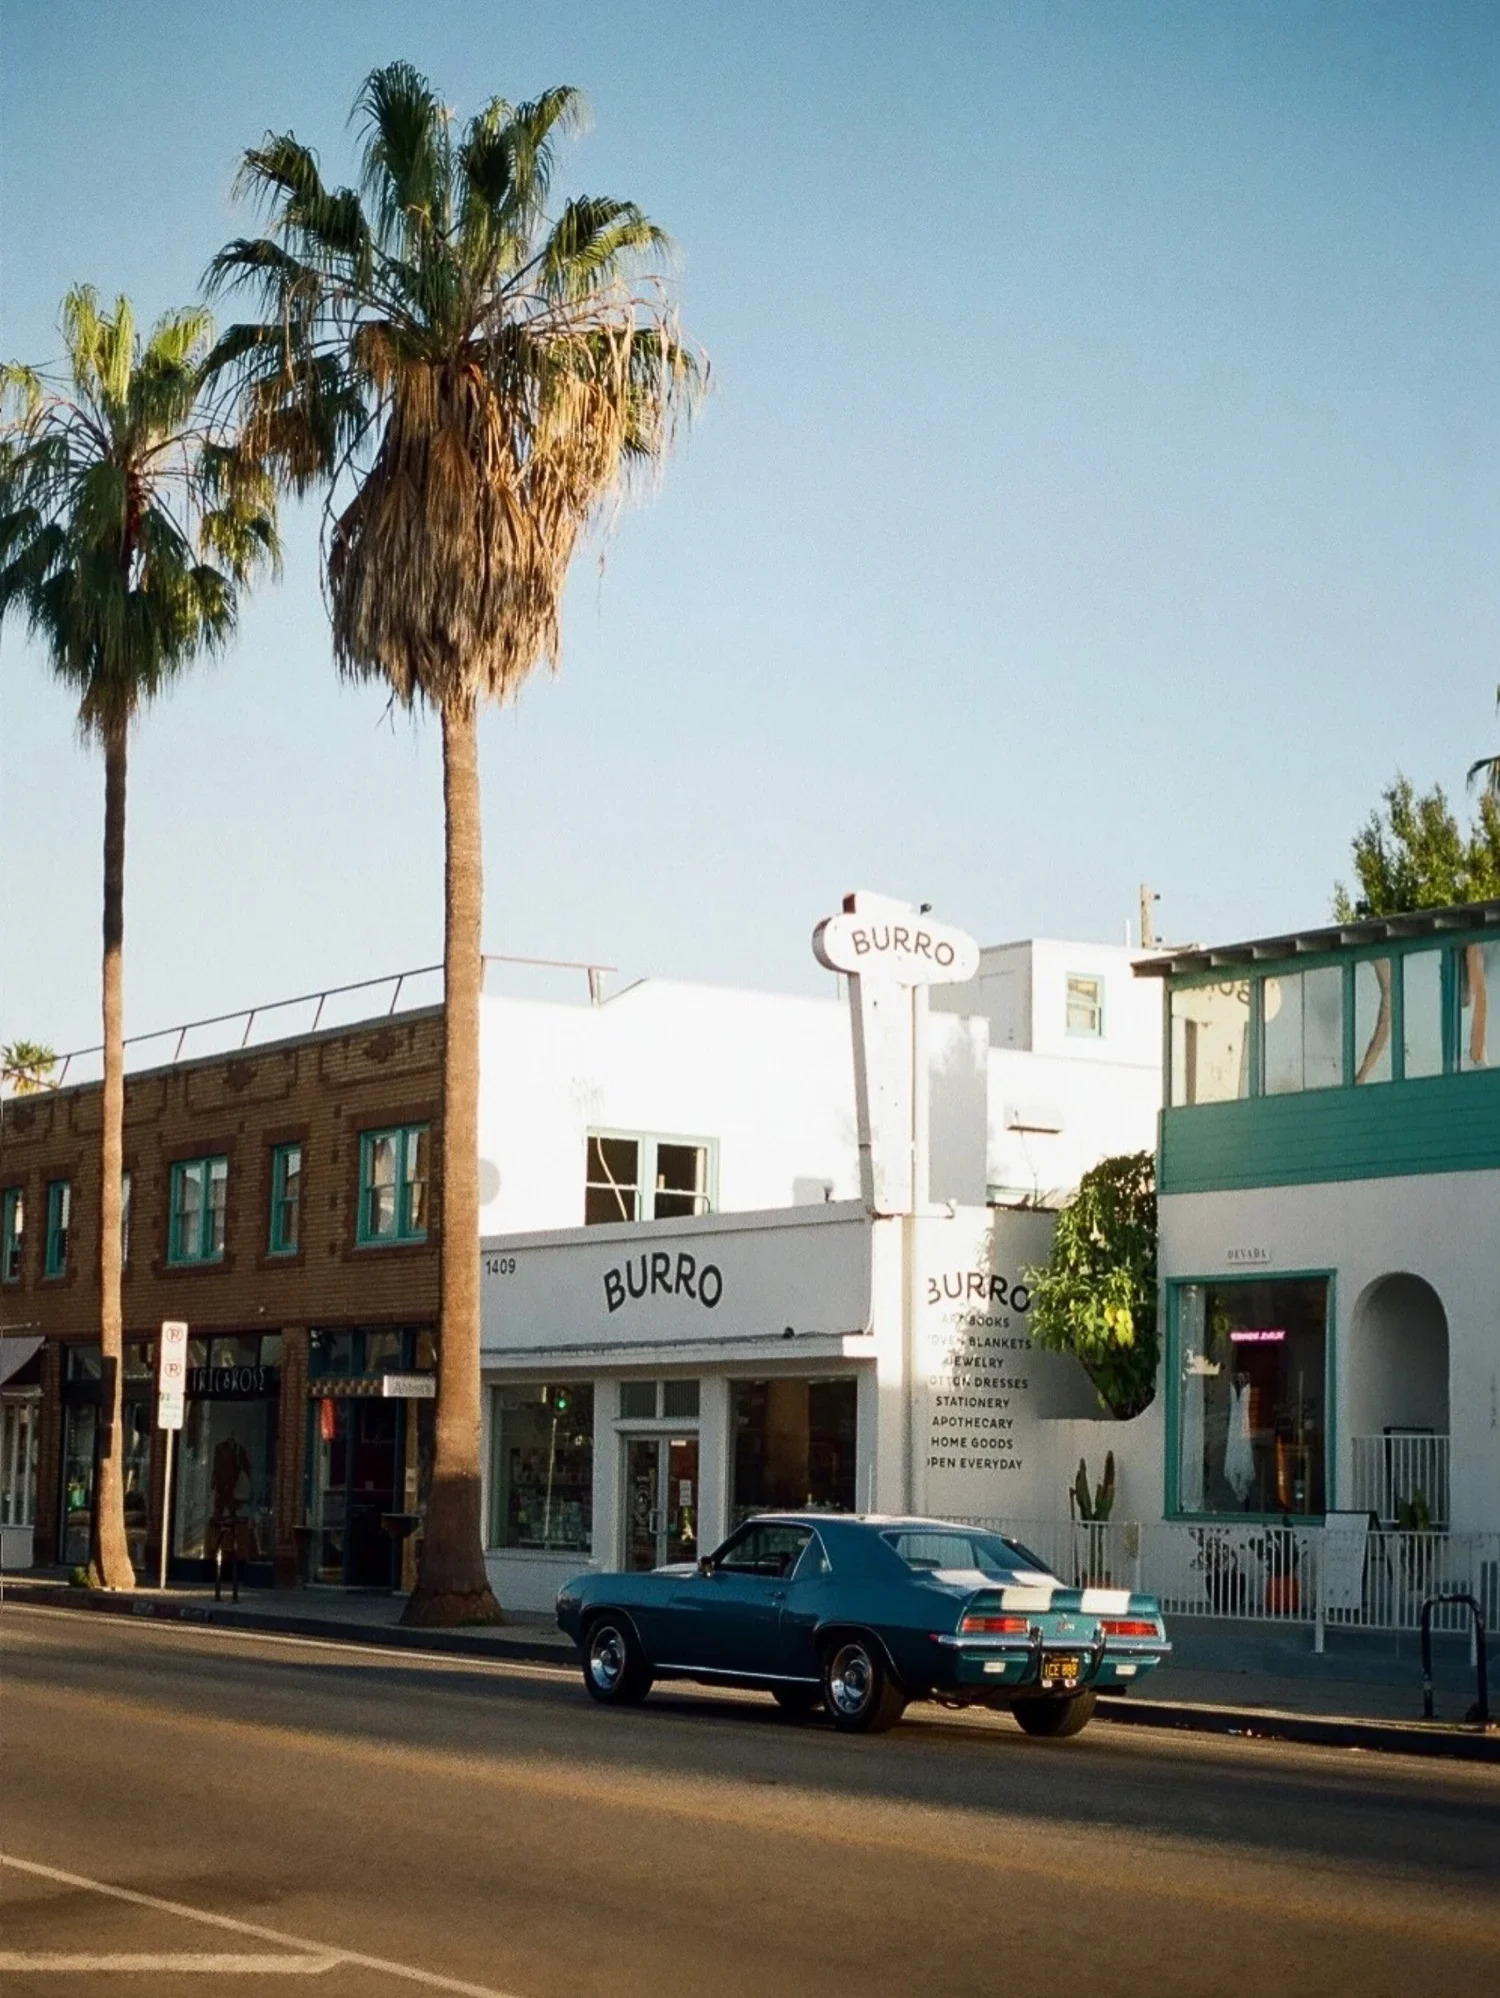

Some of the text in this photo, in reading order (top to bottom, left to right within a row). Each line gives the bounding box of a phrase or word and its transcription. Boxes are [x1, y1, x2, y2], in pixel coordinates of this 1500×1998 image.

[852, 926, 955, 967] BURRO
[485, 1258, 516, 1275] 1409
[604, 1252, 723, 1313] BURRO
[969, 1316, 1010, 1328] BOOKS
[969, 1336, 1032, 1350] BLANKETS
[974, 1376, 1029, 1389] DRESSES
[936, 1396, 1010, 1409] STATIONERY
[932, 1416, 1013, 1429] APOTHECARY
[931, 1436, 1013, 1449] HOME GOODS
[960, 1458, 1023, 1470] EVERYDAY
